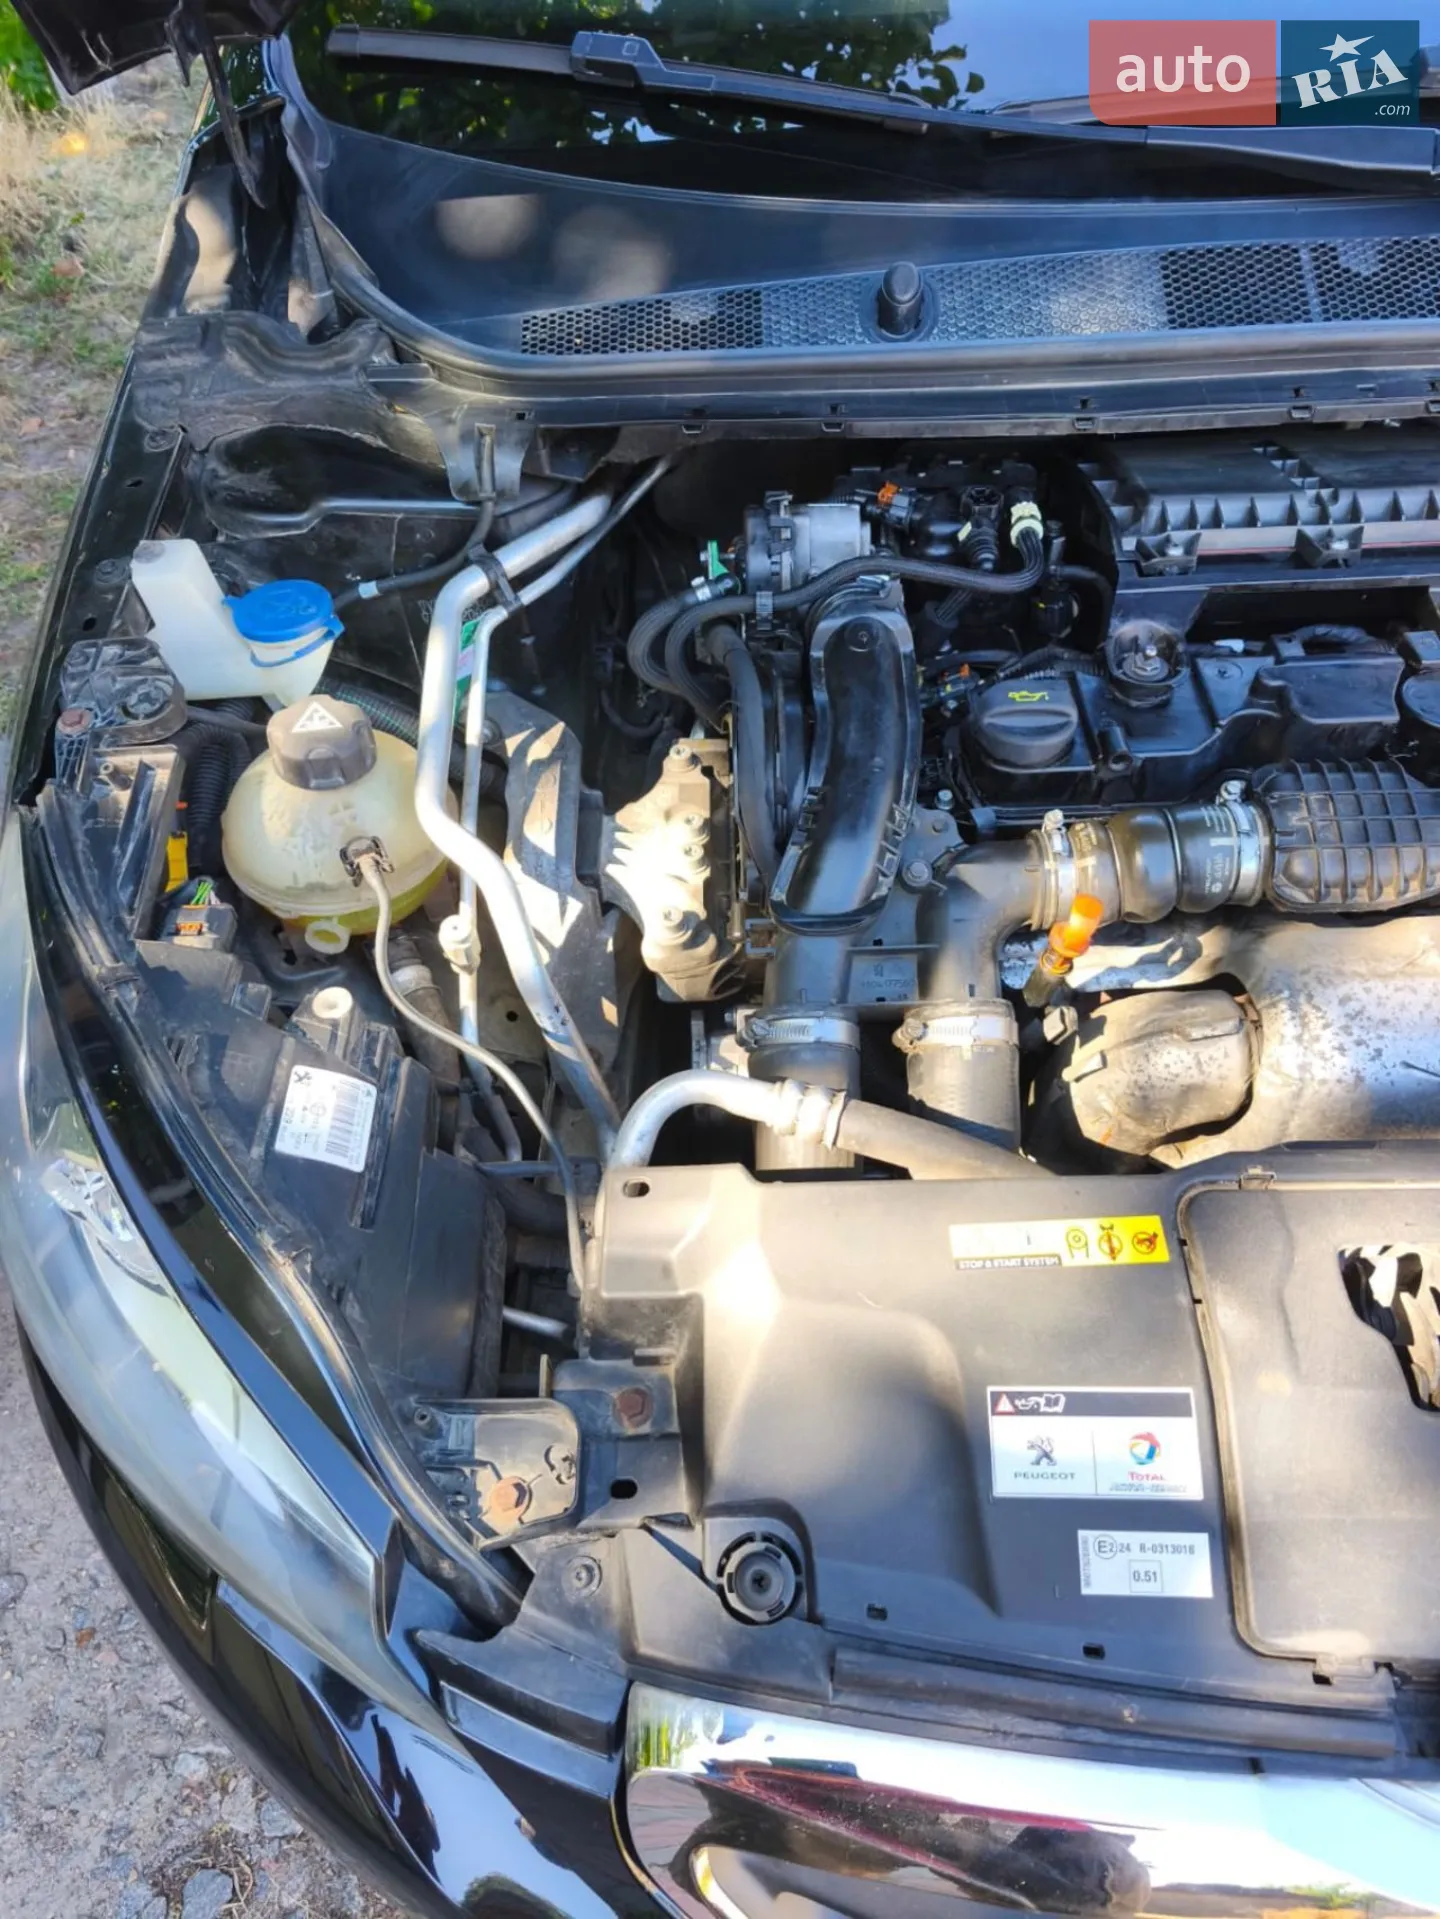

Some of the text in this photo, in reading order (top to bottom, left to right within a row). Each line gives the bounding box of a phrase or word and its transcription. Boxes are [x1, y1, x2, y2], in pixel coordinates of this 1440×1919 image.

[958, 1259, 984, 1270] STOP
[993, 1257, 1022, 1267] START
[1023, 1255, 1059, 1266] SYSTEM
[1013, 1471, 1077, 1480] PEUGEOT
[1127, 1470, 1167, 1482] TOTAL
[1118, 1542, 1132, 1553] 24
[1132, 1570, 1158, 1583] 0.51
